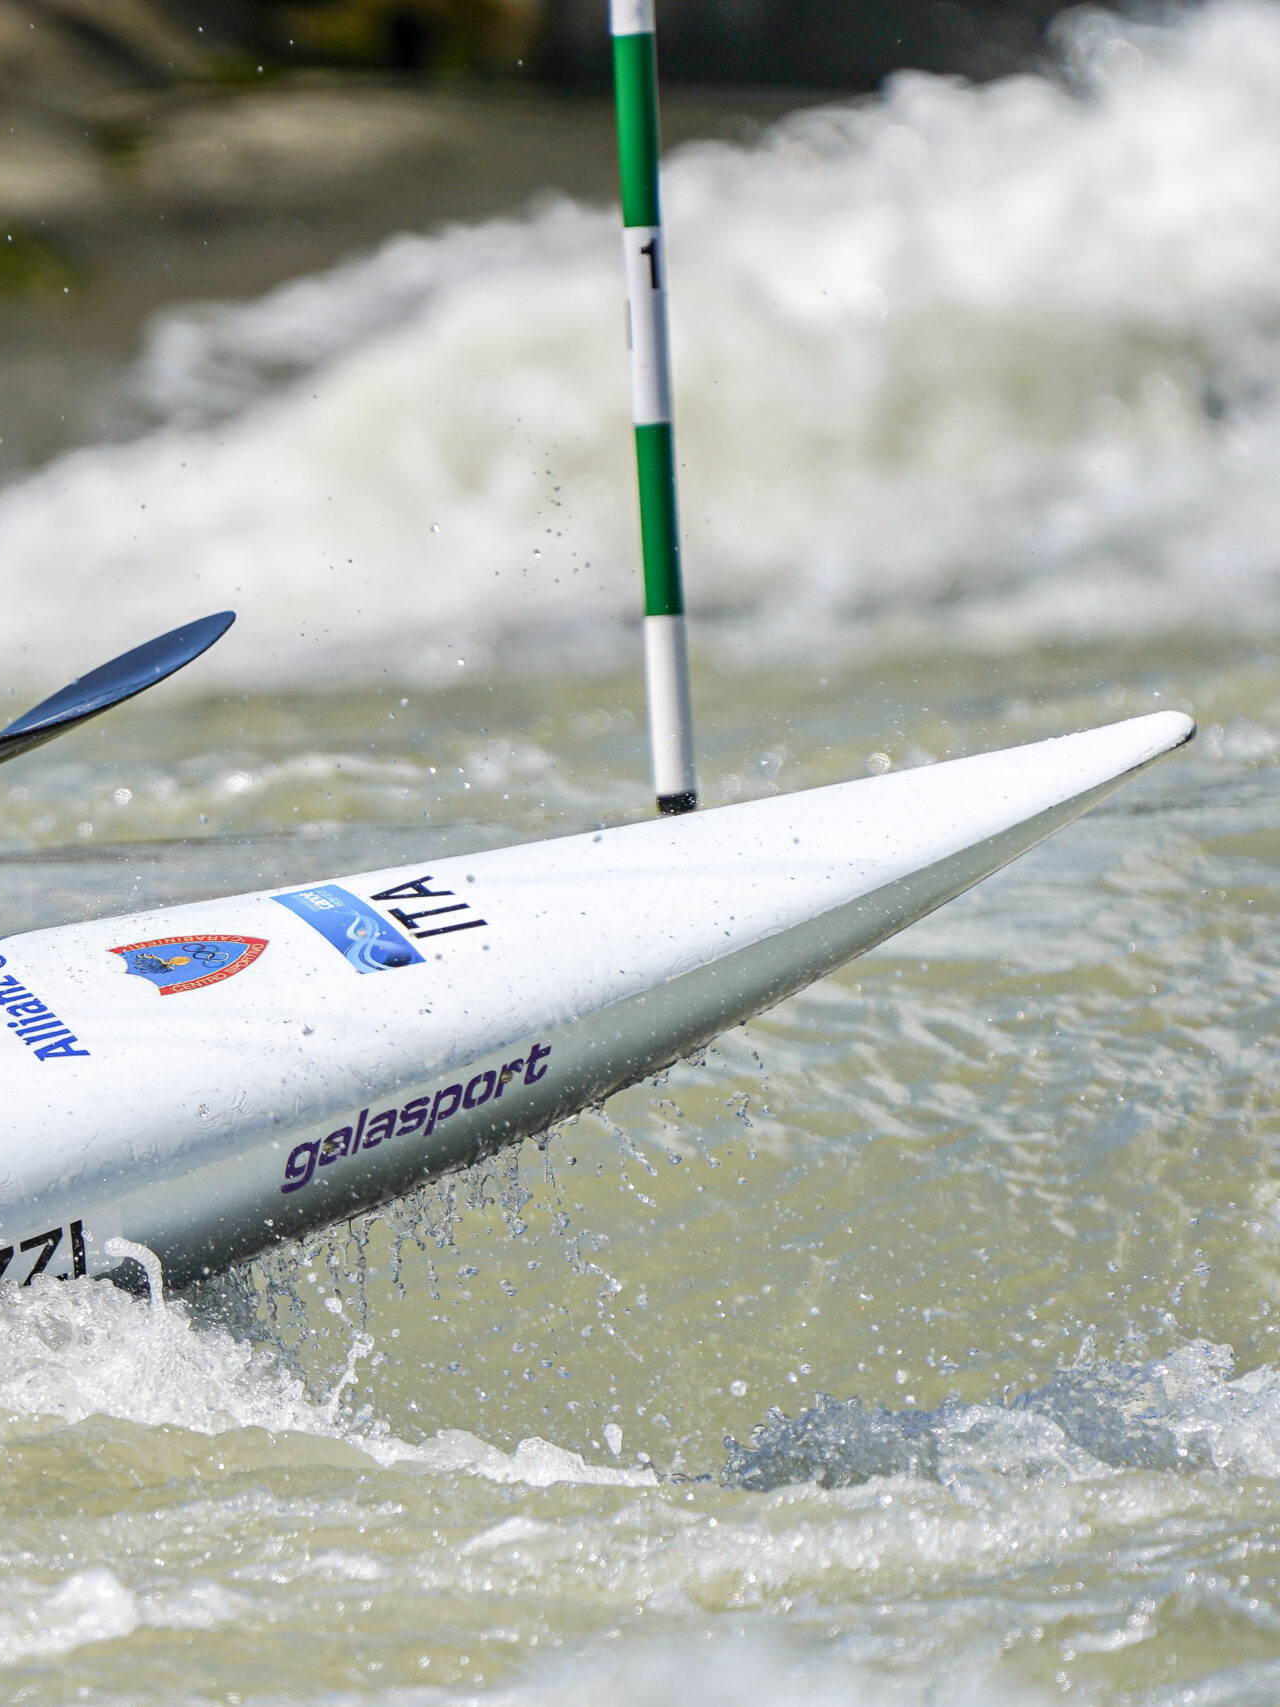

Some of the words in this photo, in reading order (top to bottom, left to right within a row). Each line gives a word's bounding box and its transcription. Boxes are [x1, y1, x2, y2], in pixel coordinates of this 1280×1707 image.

[641, 238, 660, 290] 1
[369, 875, 489, 939] ITA
[171, 972, 228, 992] CENTRO
[226, 943, 265, 974] SPORTIVO
[281, 1043, 551, 1194] galasport
